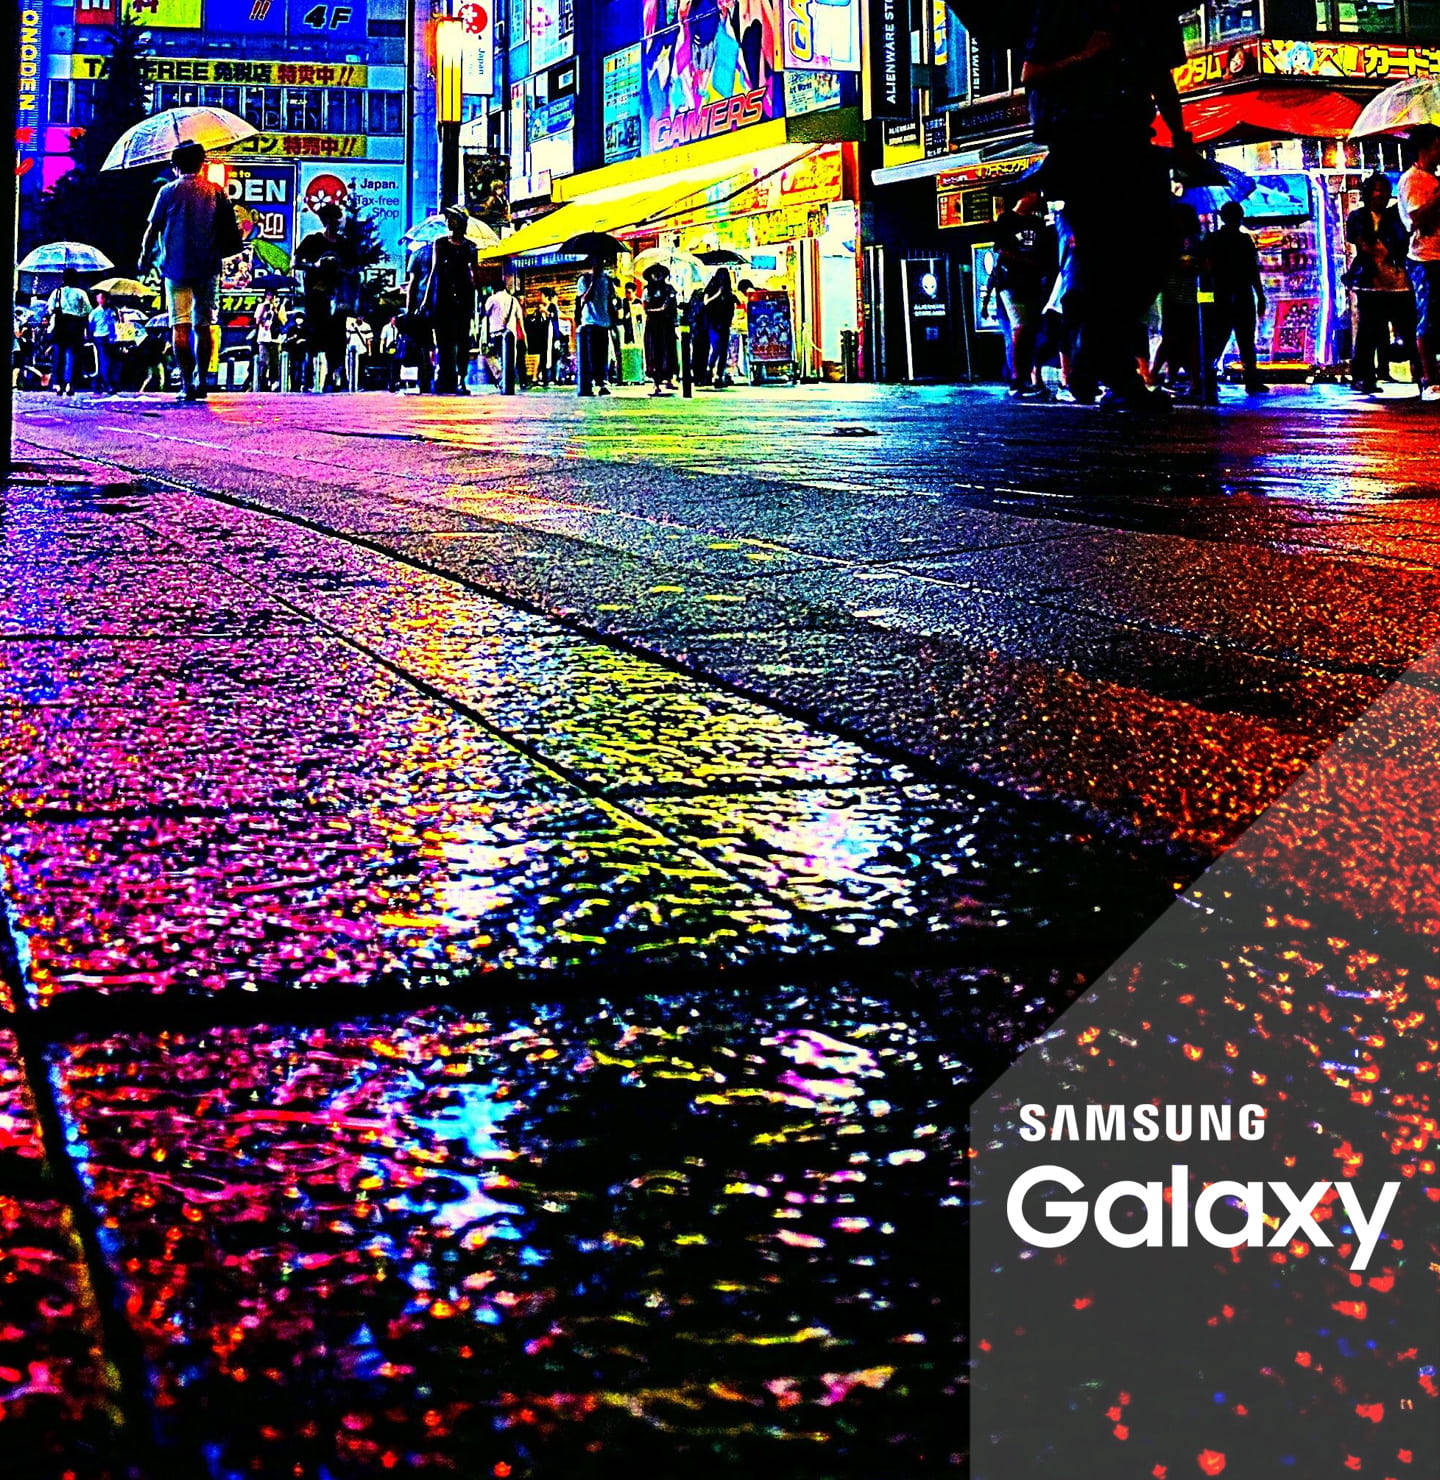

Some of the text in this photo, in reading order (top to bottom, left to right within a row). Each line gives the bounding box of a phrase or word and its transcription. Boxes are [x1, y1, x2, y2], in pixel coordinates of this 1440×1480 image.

[303, 4, 352, 30] 4F
[20, 9, 39, 111] ONODEN
[884, 24, 897, 104] ALIENWARE
[653, 86, 767, 152] GAMERS
[360, 177, 399, 191] Japan.
[357, 194, 400, 206] Tax-free
[372, 207, 400, 219] Shop
